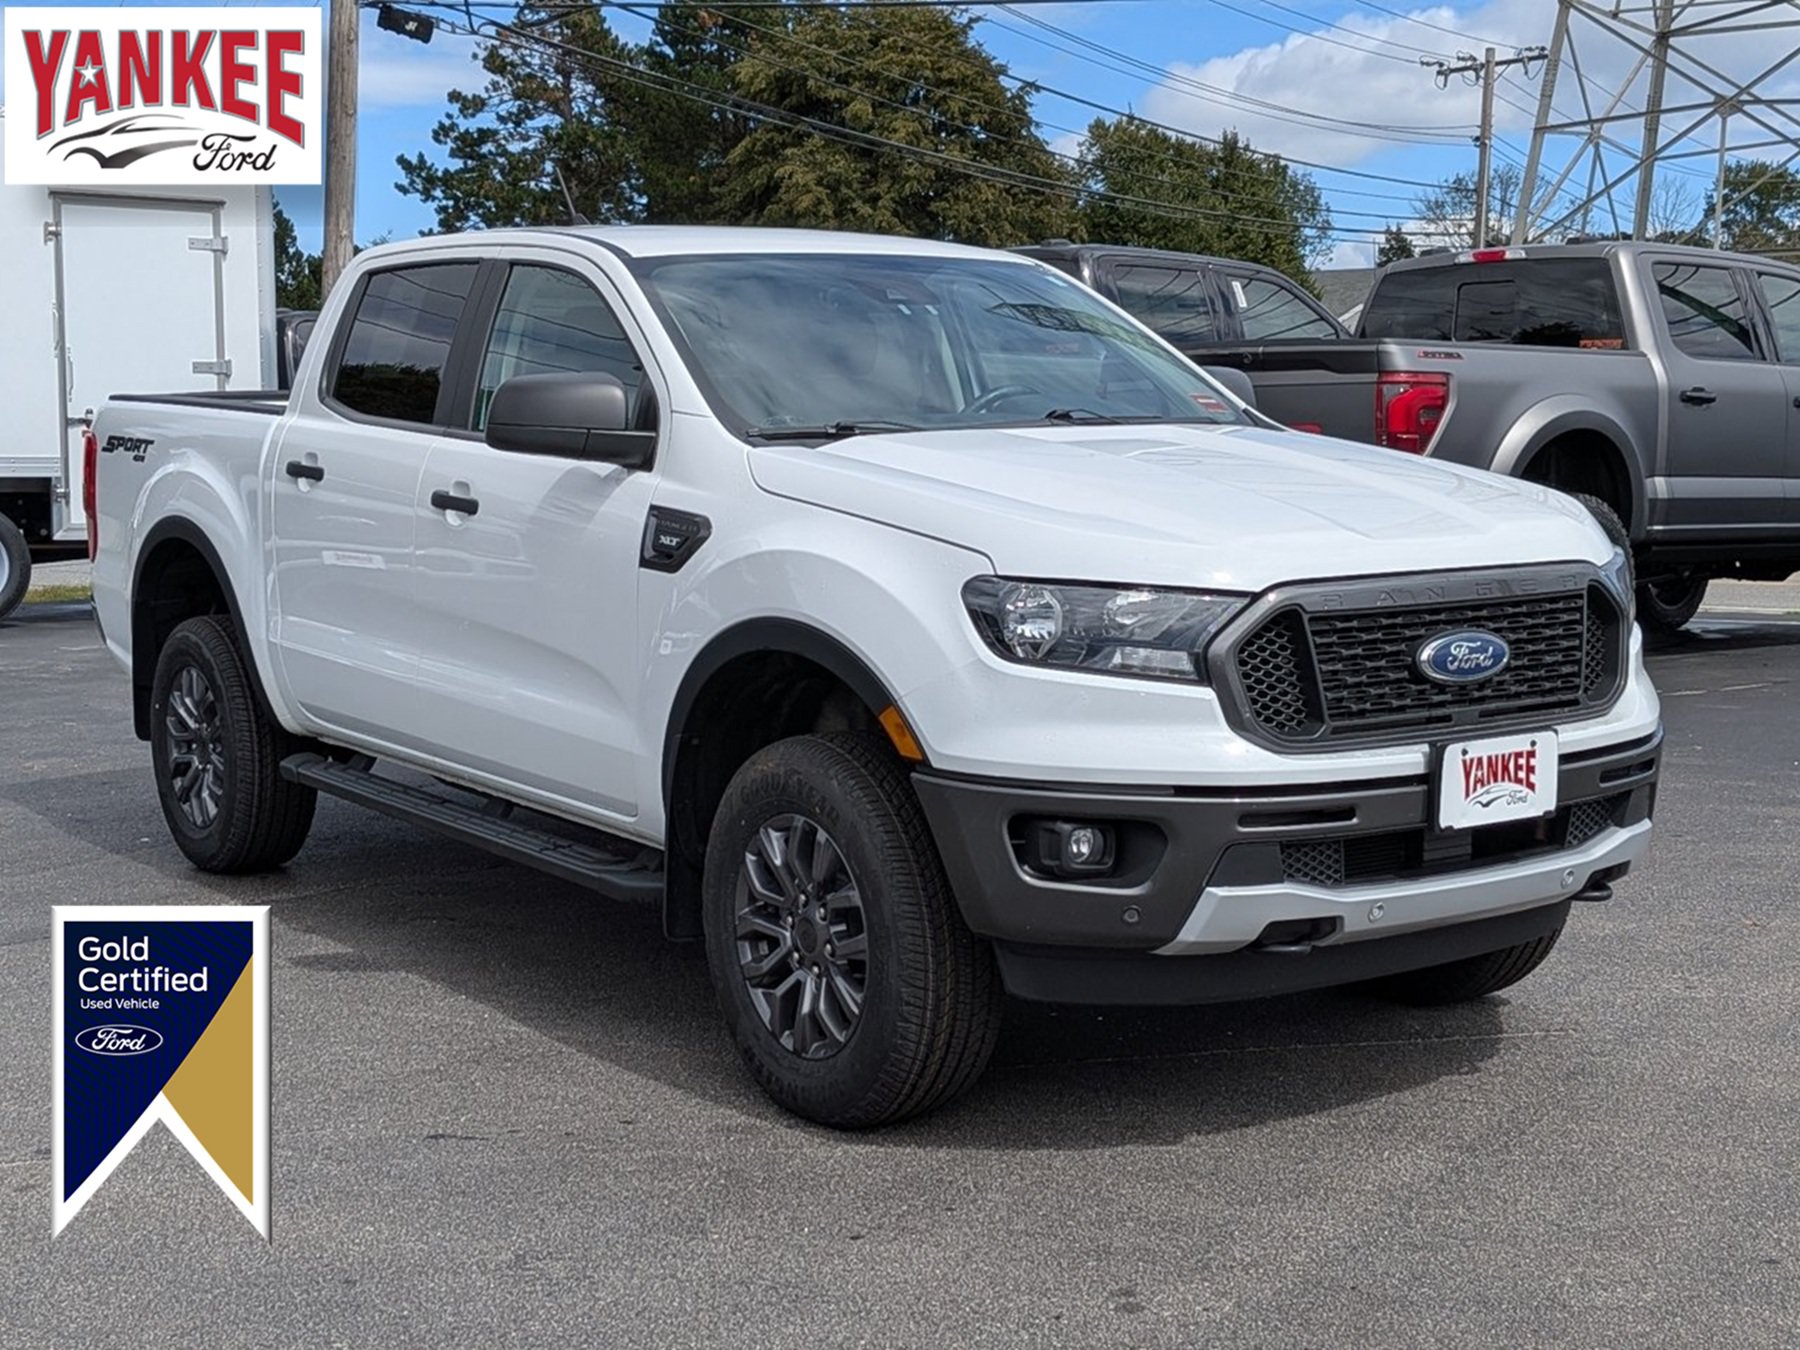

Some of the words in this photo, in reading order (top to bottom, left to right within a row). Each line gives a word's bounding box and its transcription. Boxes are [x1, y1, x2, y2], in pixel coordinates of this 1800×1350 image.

[101, 435, 155, 453] SPORT
[1446, 641, 1494, 671] Ford
[1461, 748, 1537, 801] YANKEE
[1506, 789, 1529, 806] Ford
